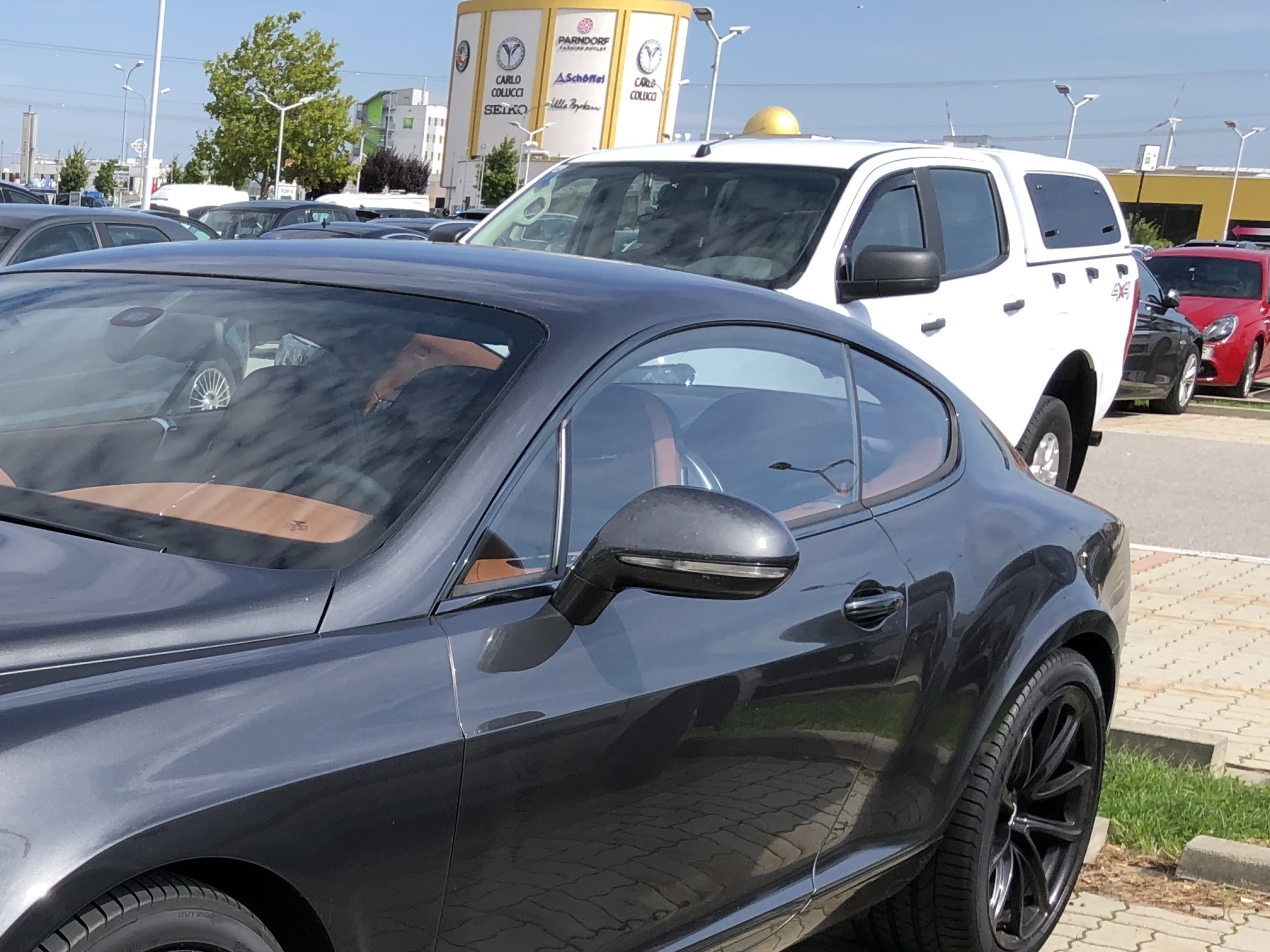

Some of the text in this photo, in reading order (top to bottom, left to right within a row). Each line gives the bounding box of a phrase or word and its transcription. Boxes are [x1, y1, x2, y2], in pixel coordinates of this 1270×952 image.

[558, 36, 610, 45] PARNDORF
[495, 75, 522, 84] CARLO
[565, 73, 605, 83] Schöffel
[491, 88, 524, 97] COLUCCI
[630, 90, 657, 101] COLUCCI
[484, 104, 528, 115] SEIKO
